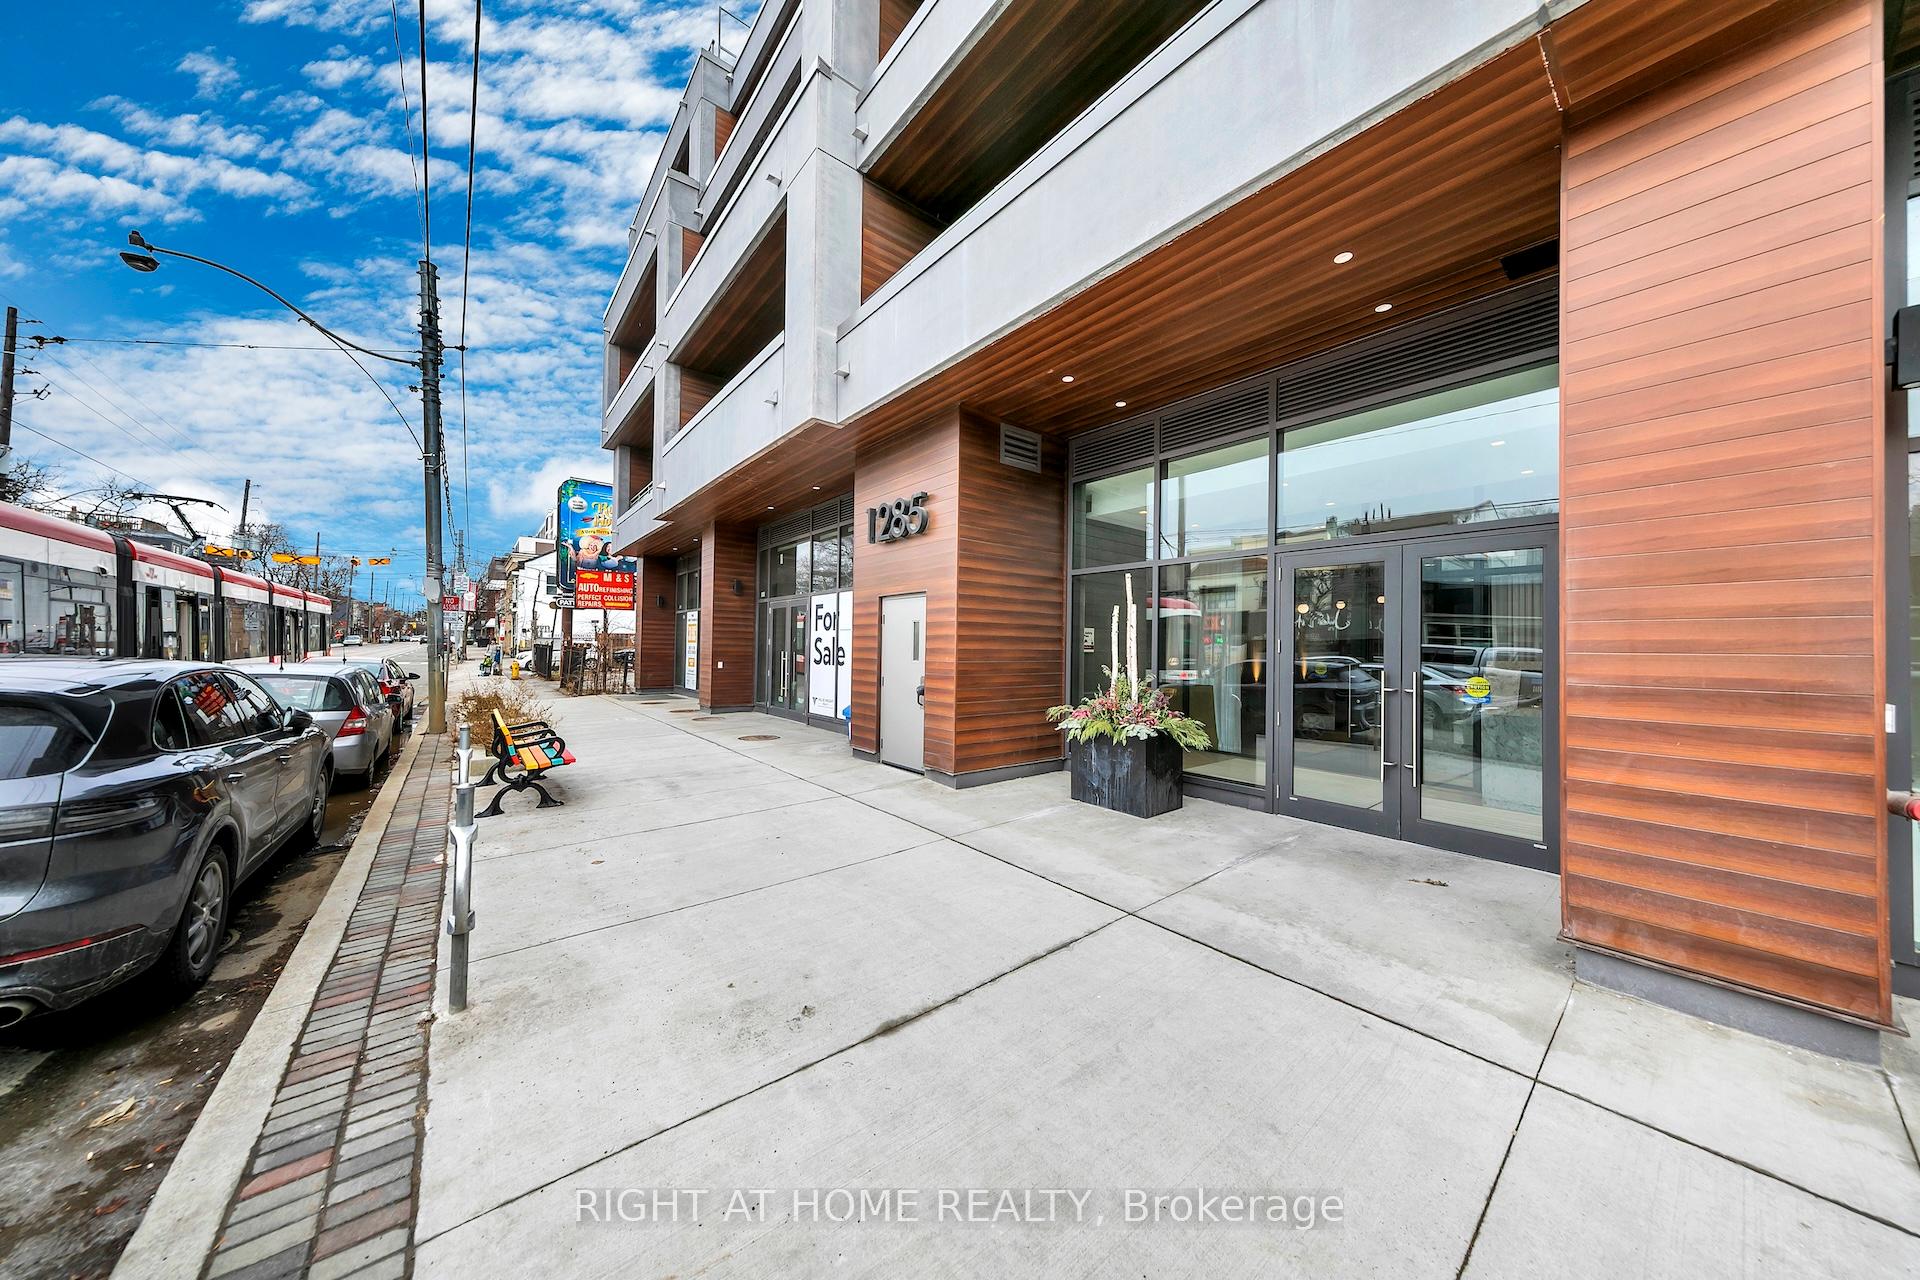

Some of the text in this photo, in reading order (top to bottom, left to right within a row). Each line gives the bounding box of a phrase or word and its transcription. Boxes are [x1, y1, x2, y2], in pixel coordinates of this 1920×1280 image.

[865, 491, 929, 545] 1285
[578, 583, 599, 592] AUTO
[603, 573, 630, 583] M & S
[815, 604, 840, 631] For
[813, 637, 846, 667] Sale
